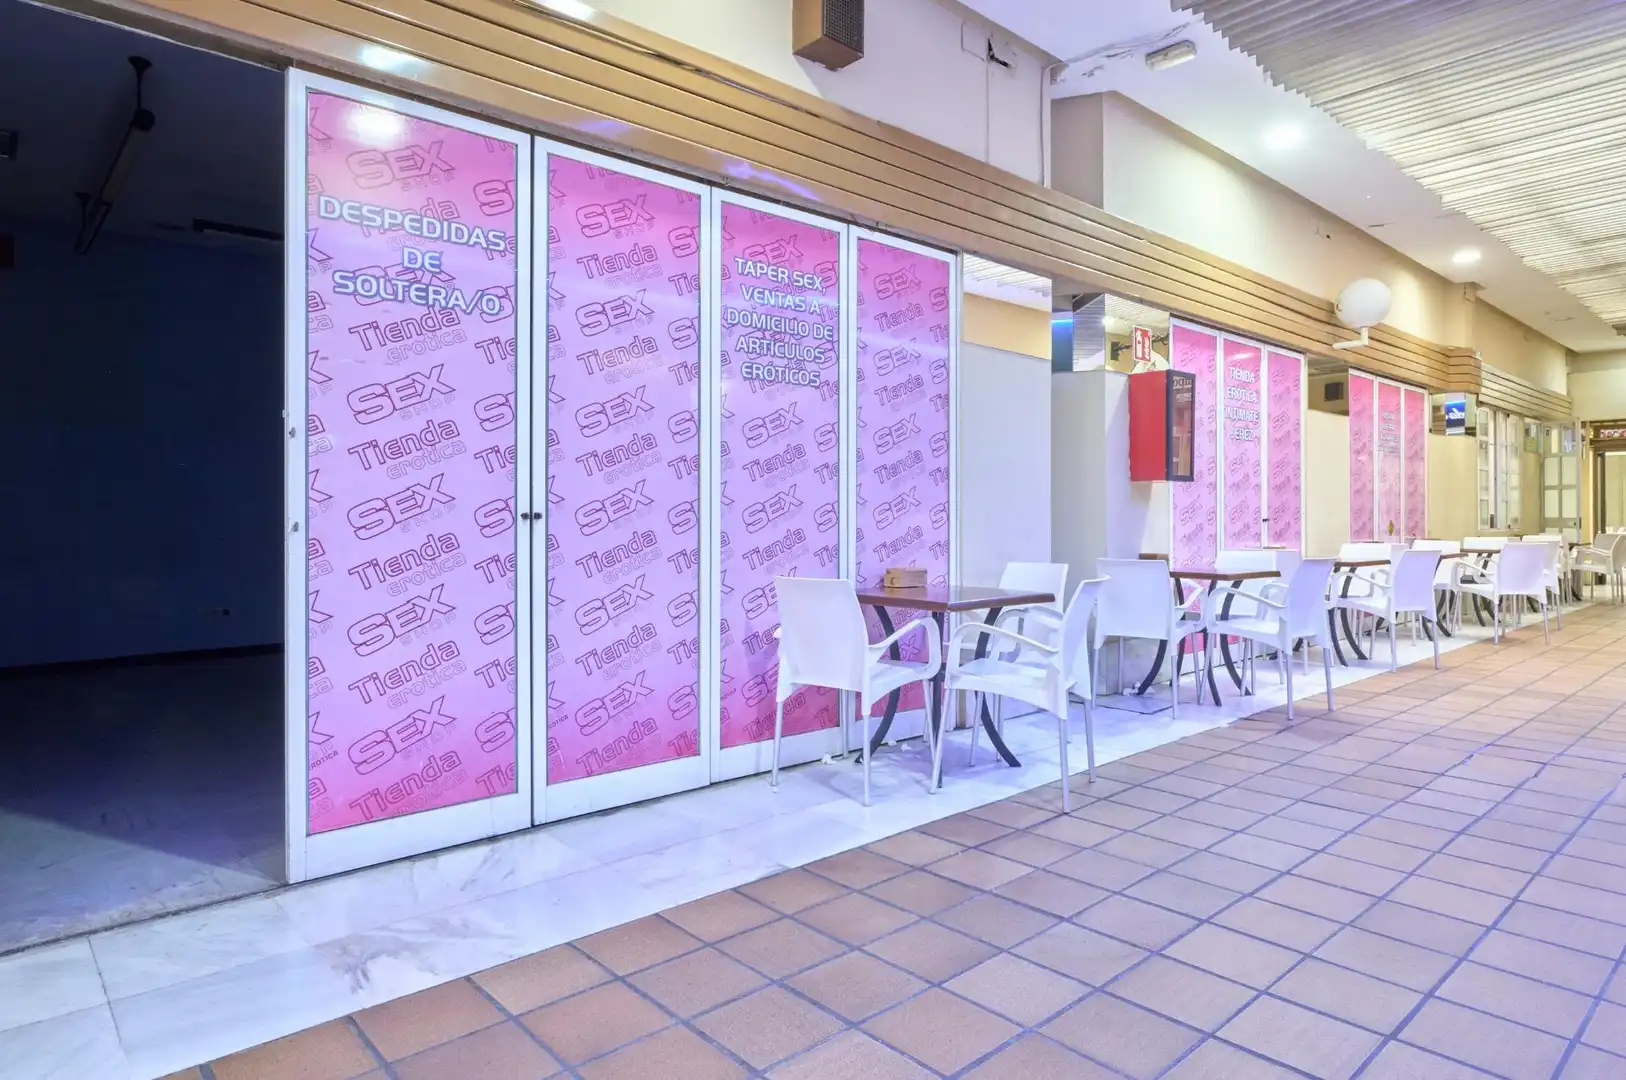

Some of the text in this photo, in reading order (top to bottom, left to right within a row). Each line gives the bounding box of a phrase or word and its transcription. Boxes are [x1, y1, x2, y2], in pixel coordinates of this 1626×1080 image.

[346, 141, 456, 190] SEX
[318, 195, 506, 252] DESPEDIDAS
[576, 194, 655, 238] SEX
[402, 246, 443, 273] DE
[576, 242, 658, 279] Tienda
[734, 256, 827, 296] TAPER SEX,
[874, 264, 922, 300] SEX
[332, 270, 501, 316] SOLTERA/O
[575, 288, 655, 337] SEX
[740, 284, 806, 312] VENTAS
[810, 298, 822, 316] A
[348, 306, 460, 351] Tienda
[726, 308, 810, 336] DOMICILIO
[812, 322, 834, 341] DE
[874, 302, 924, 332] Tienda
[576, 335, 658, 375] Tienda
[741, 360, 821, 388] ERÓTICOS
[874, 338, 922, 376] SEX
[1228, 366, 1256, 384] TIENDA
[347, 364, 456, 425] SEX
[574, 385, 655, 438] SEX
[874, 374, 924, 406] Tienda
[348, 419, 460, 470] Tienda
[742, 402, 804, 448] SEX
[873, 412, 922, 454] SEX
[576, 432, 658, 477] Tienda
[742, 444, 806, 482] Tienda
[874, 449, 924, 484] Tienda
[347, 472, 456, 540] SEX
[574, 478, 655, 536] SEX
[742, 484, 804, 534] SEX
[872, 486, 921, 530] SEX
[348, 532, 460, 590] Tienda
[575, 530, 658, 578] Tienda
[742, 528, 806, 570] Tienda
[873, 525, 924, 562] Tienda
[347, 584, 456, 656] SEX
[574, 574, 655, 636] SEX
[575, 622, 658, 676] Tienda
[348, 640, 460, 704] Tienda
[574, 670, 656, 736] SEX
[348, 694, 458, 776] SEX
[576, 718, 658, 776] Tienda
[309, 750, 339, 772] ROTICA
[349, 750, 462, 821] Tienda
